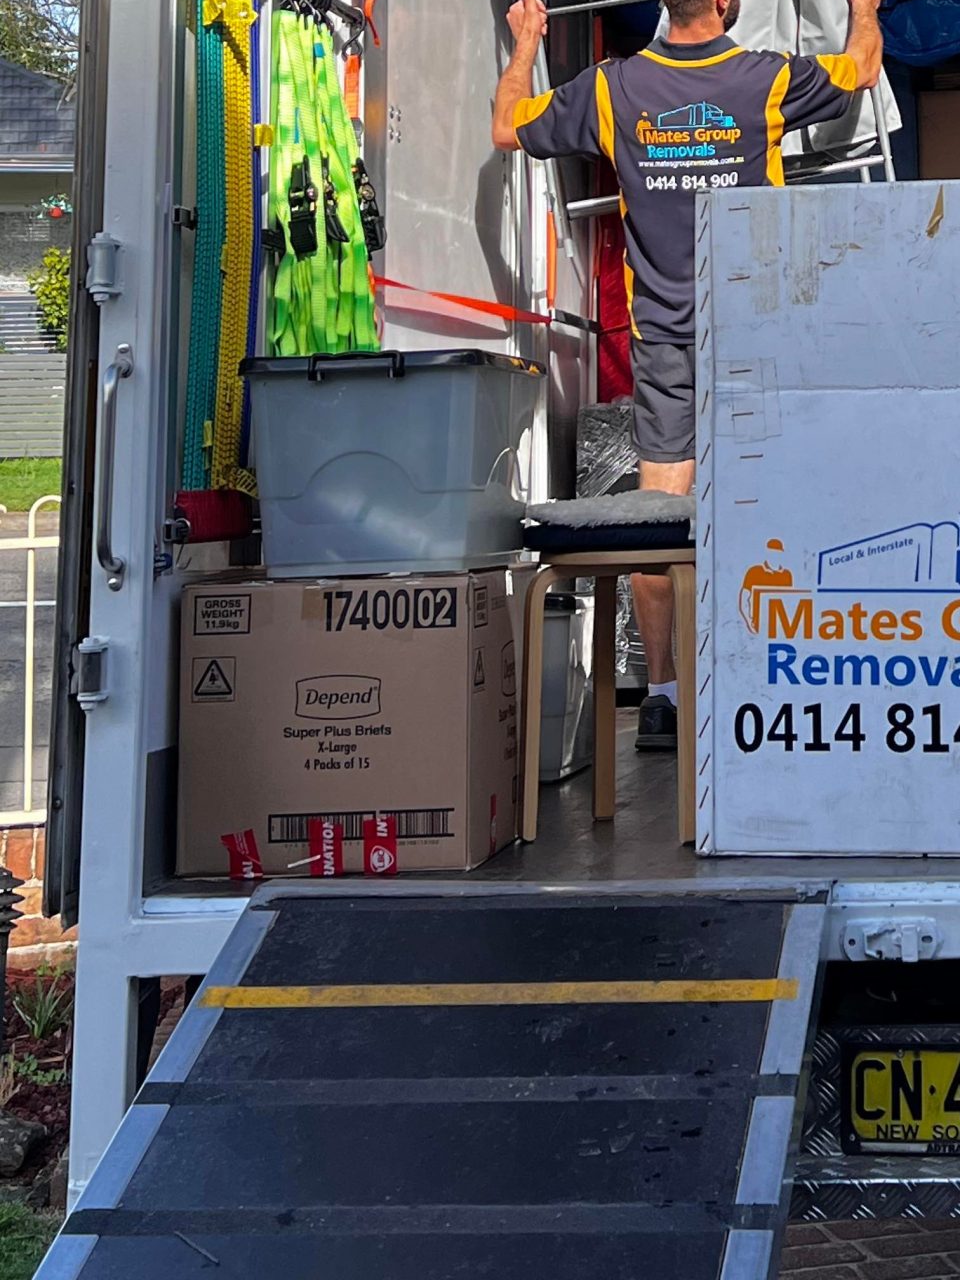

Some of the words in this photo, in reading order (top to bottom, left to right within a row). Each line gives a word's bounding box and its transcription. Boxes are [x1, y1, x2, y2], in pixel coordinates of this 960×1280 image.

[645, 129, 691, 145] Mates
[694, 127, 742, 144] Group
[647, 142, 716, 159] Removals
[645, 175, 678, 190] 0414
[681, 173, 708, 190] 814
[710, 171, 739, 188] 900
[828, 551, 854, 567] Local
[855, 549, 865, 559] &
[867, 537, 914, 557] Interstate
[204, 599, 241, 609] GROSS
[201, 608, 245, 619] WEIGHT
[767, 598, 924, 642] Mates
[305, 685, 374, 710] Depend
[283, 726, 321, 740] Super
[324, 725, 352, 737] Plus
[355, 724, 392, 736] Briefs
[734, 702, 867, 753] 0414
[318, 741, 358, 756] X-Large
[304, 758, 311, 771] 4
[313, 757, 341, 771] Packs
[344, 756, 355, 770] of
[358, 756, 370, 769] 15
[875, 1124, 920, 1141] NEW
